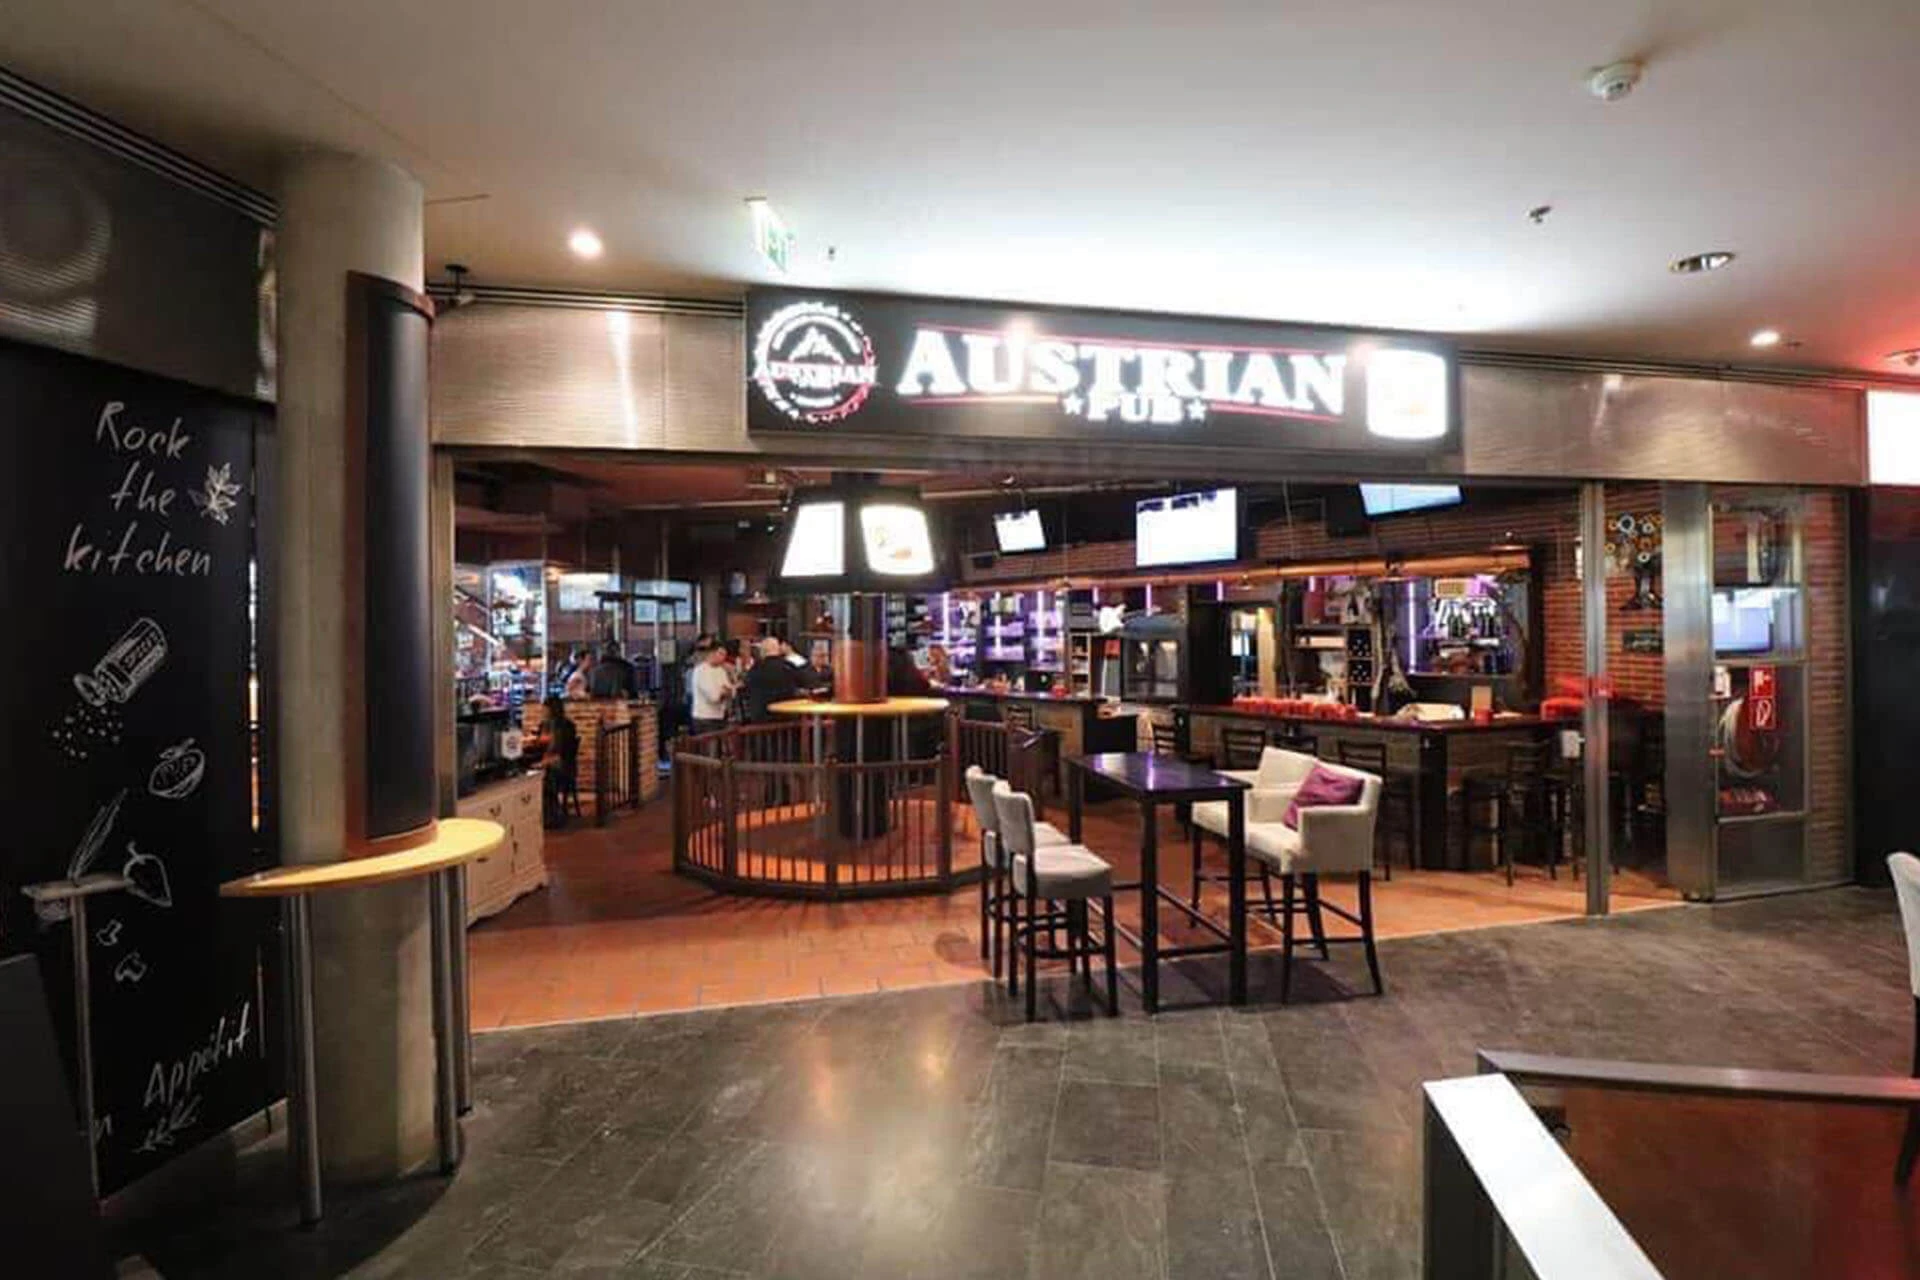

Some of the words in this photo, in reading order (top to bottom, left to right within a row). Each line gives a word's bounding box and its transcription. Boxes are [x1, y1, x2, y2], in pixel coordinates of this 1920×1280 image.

[896, 330, 1347, 415] AUSTRIAN
[96, 401, 190, 459] Rock
[1086, 391, 1185, 424] PUB
[110, 460, 176, 516] the
[63, 520, 212, 576] kitchen
